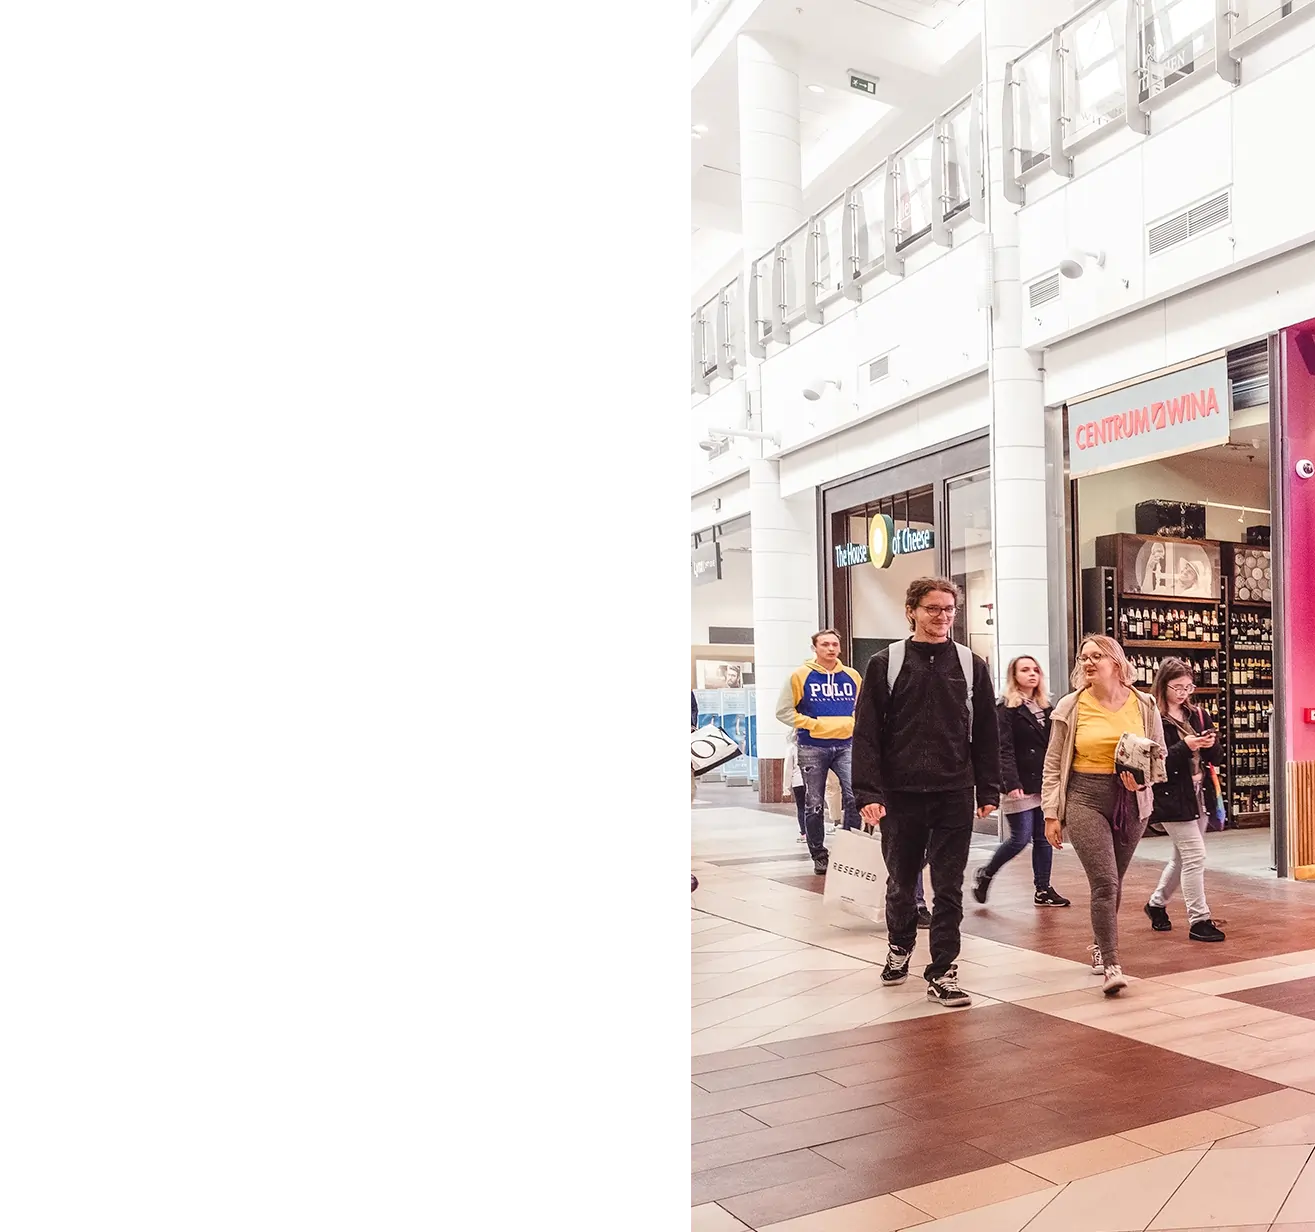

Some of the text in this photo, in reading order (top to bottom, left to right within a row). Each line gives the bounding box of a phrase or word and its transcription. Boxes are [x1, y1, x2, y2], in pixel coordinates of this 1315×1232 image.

[1075, 387, 1220, 451] CENTRUM WINA
[835, 527, 930, 568] The House of Cheese
[809, 682, 854, 697] POLO
[832, 861, 878, 882] RESERVED
